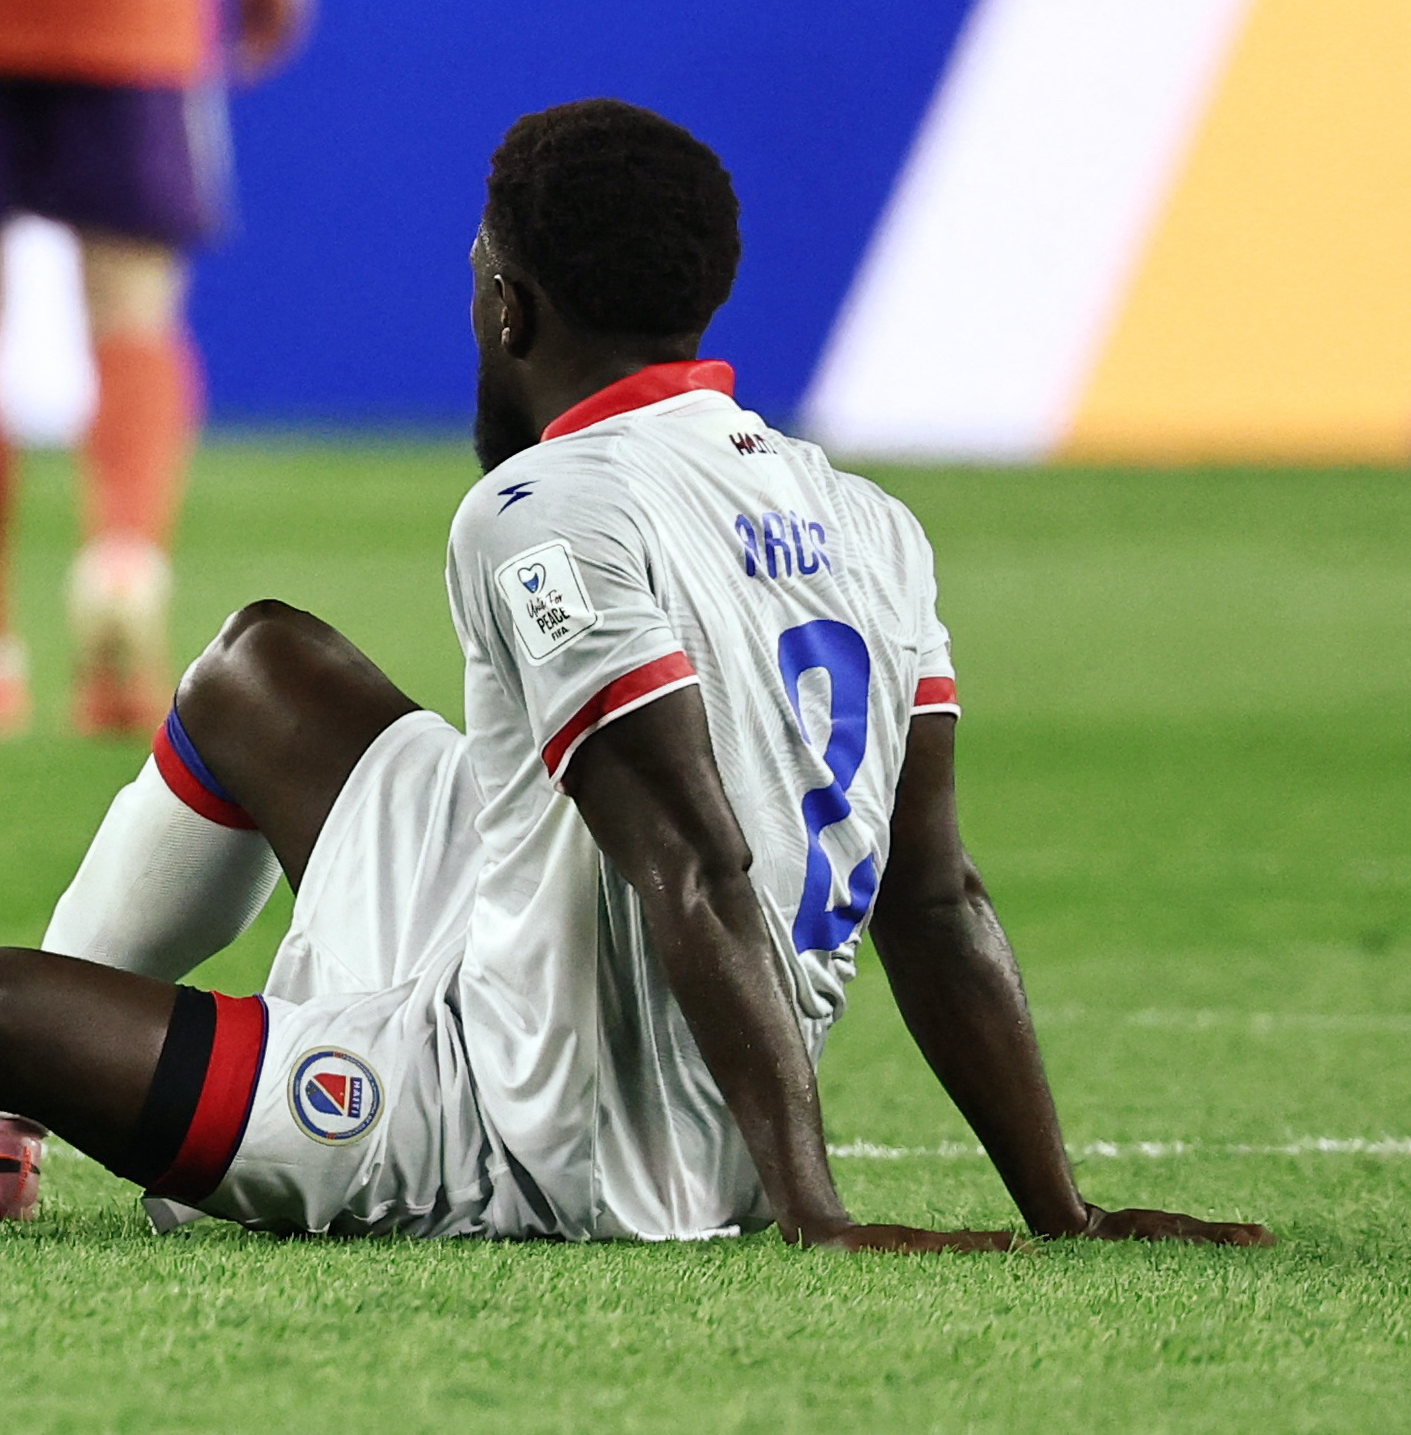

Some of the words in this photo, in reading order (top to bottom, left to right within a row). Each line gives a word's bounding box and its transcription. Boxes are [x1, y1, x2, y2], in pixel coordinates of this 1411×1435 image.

[536, 607, 571, 635] PEACE
[551, 626, 570, 642] FIFA
[778, 619, 877, 954] 2
[351, 1080, 361, 1115] HAITI
